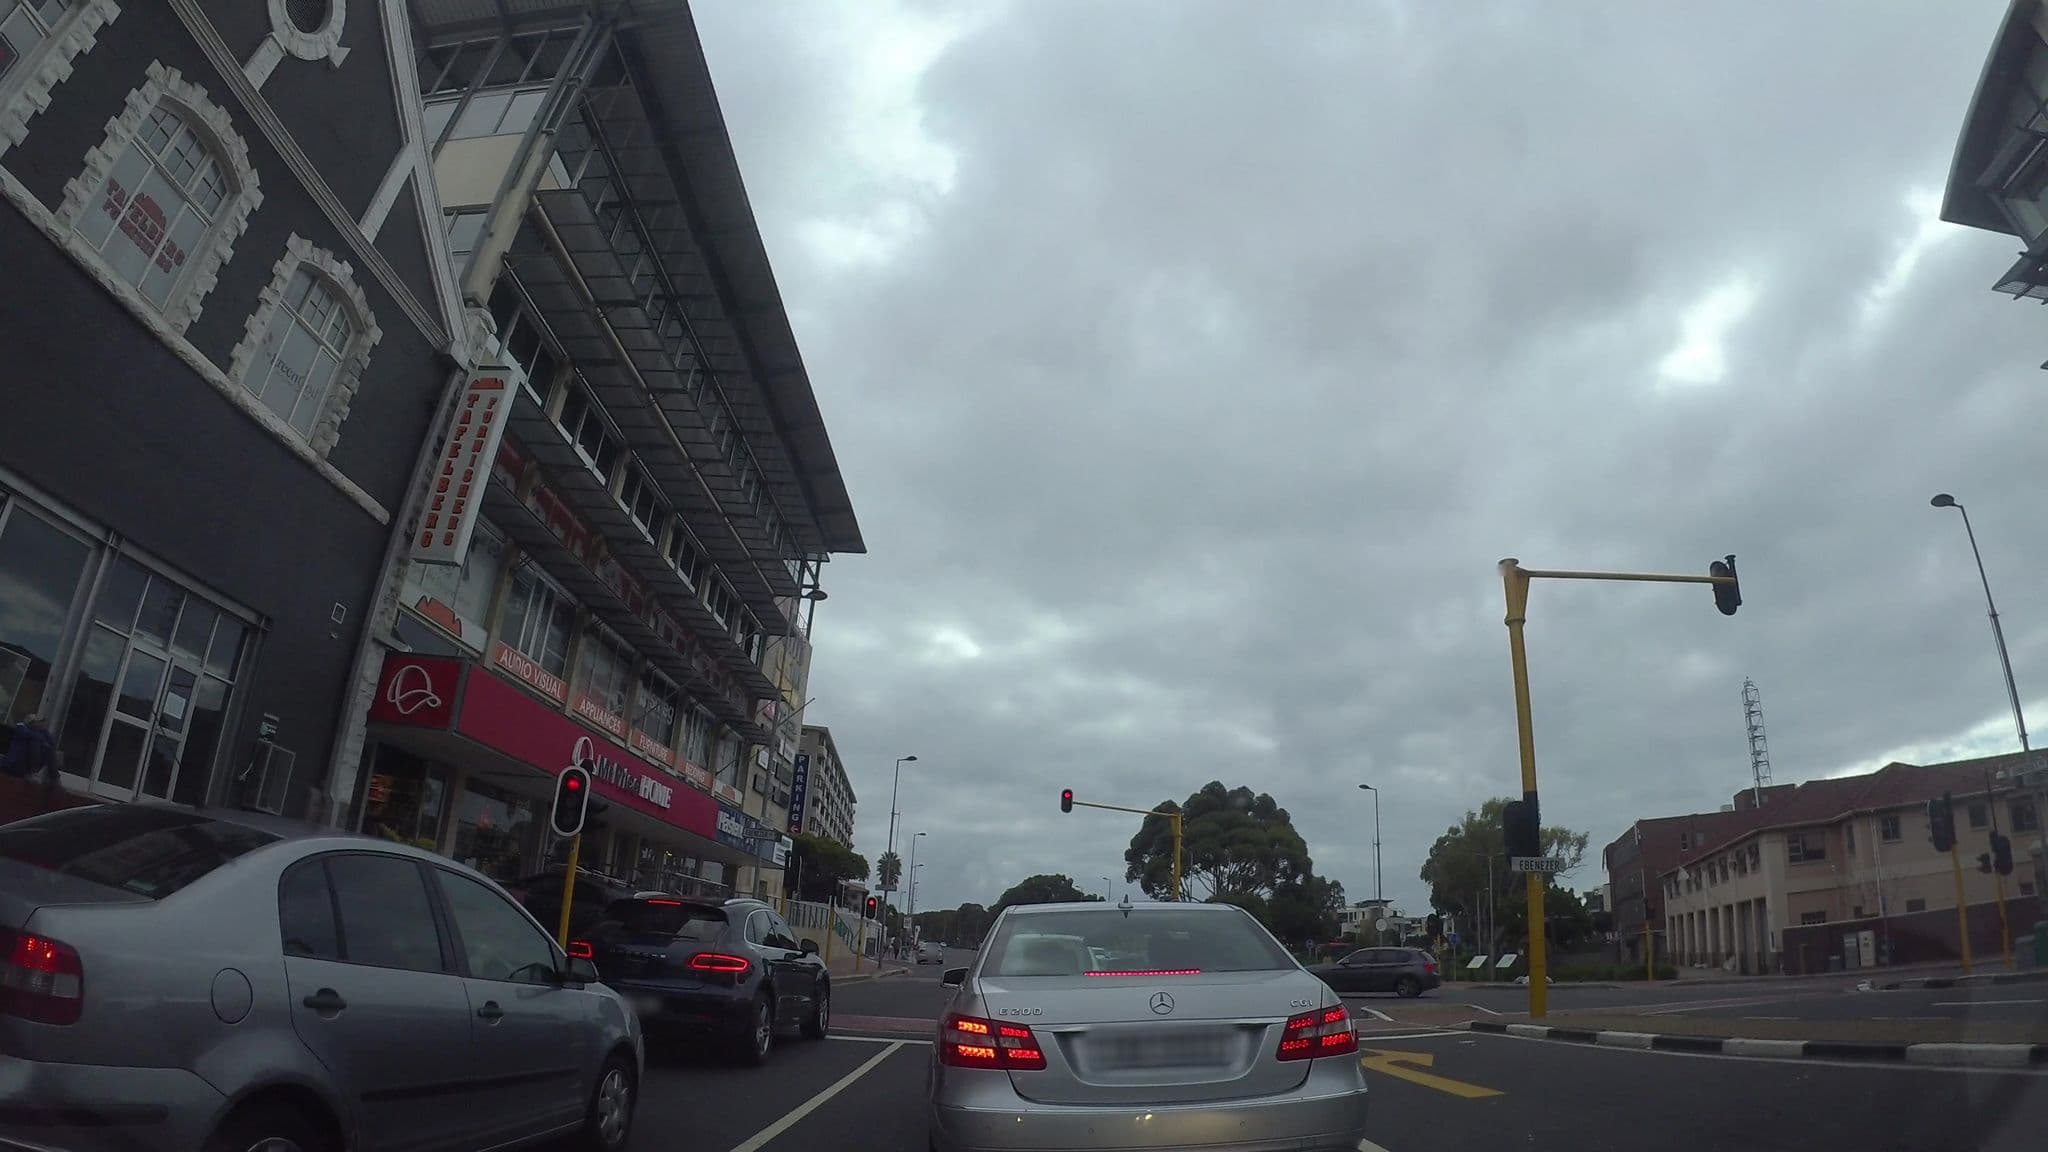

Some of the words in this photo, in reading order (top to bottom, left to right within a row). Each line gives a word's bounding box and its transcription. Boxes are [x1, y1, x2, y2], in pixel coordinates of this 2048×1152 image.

[421, 394, 480, 547] TAFELBERG
[443, 397, 498, 546] FURNISHERS
[500, 648, 532, 679] AUDIO
[534, 668, 561, 698] VISUAL
[579, 698, 621, 735] APPLIANCES
[638, 774, 673, 809] HOME
[791, 755, 806, 821] PARKING
[1519, 859, 1560, 871] EBENEZER
[999, 1007, 1008, 1016] E
[1011, 1007, 1043, 1016] 200
[1289, 998, 1313, 1008] CGI
